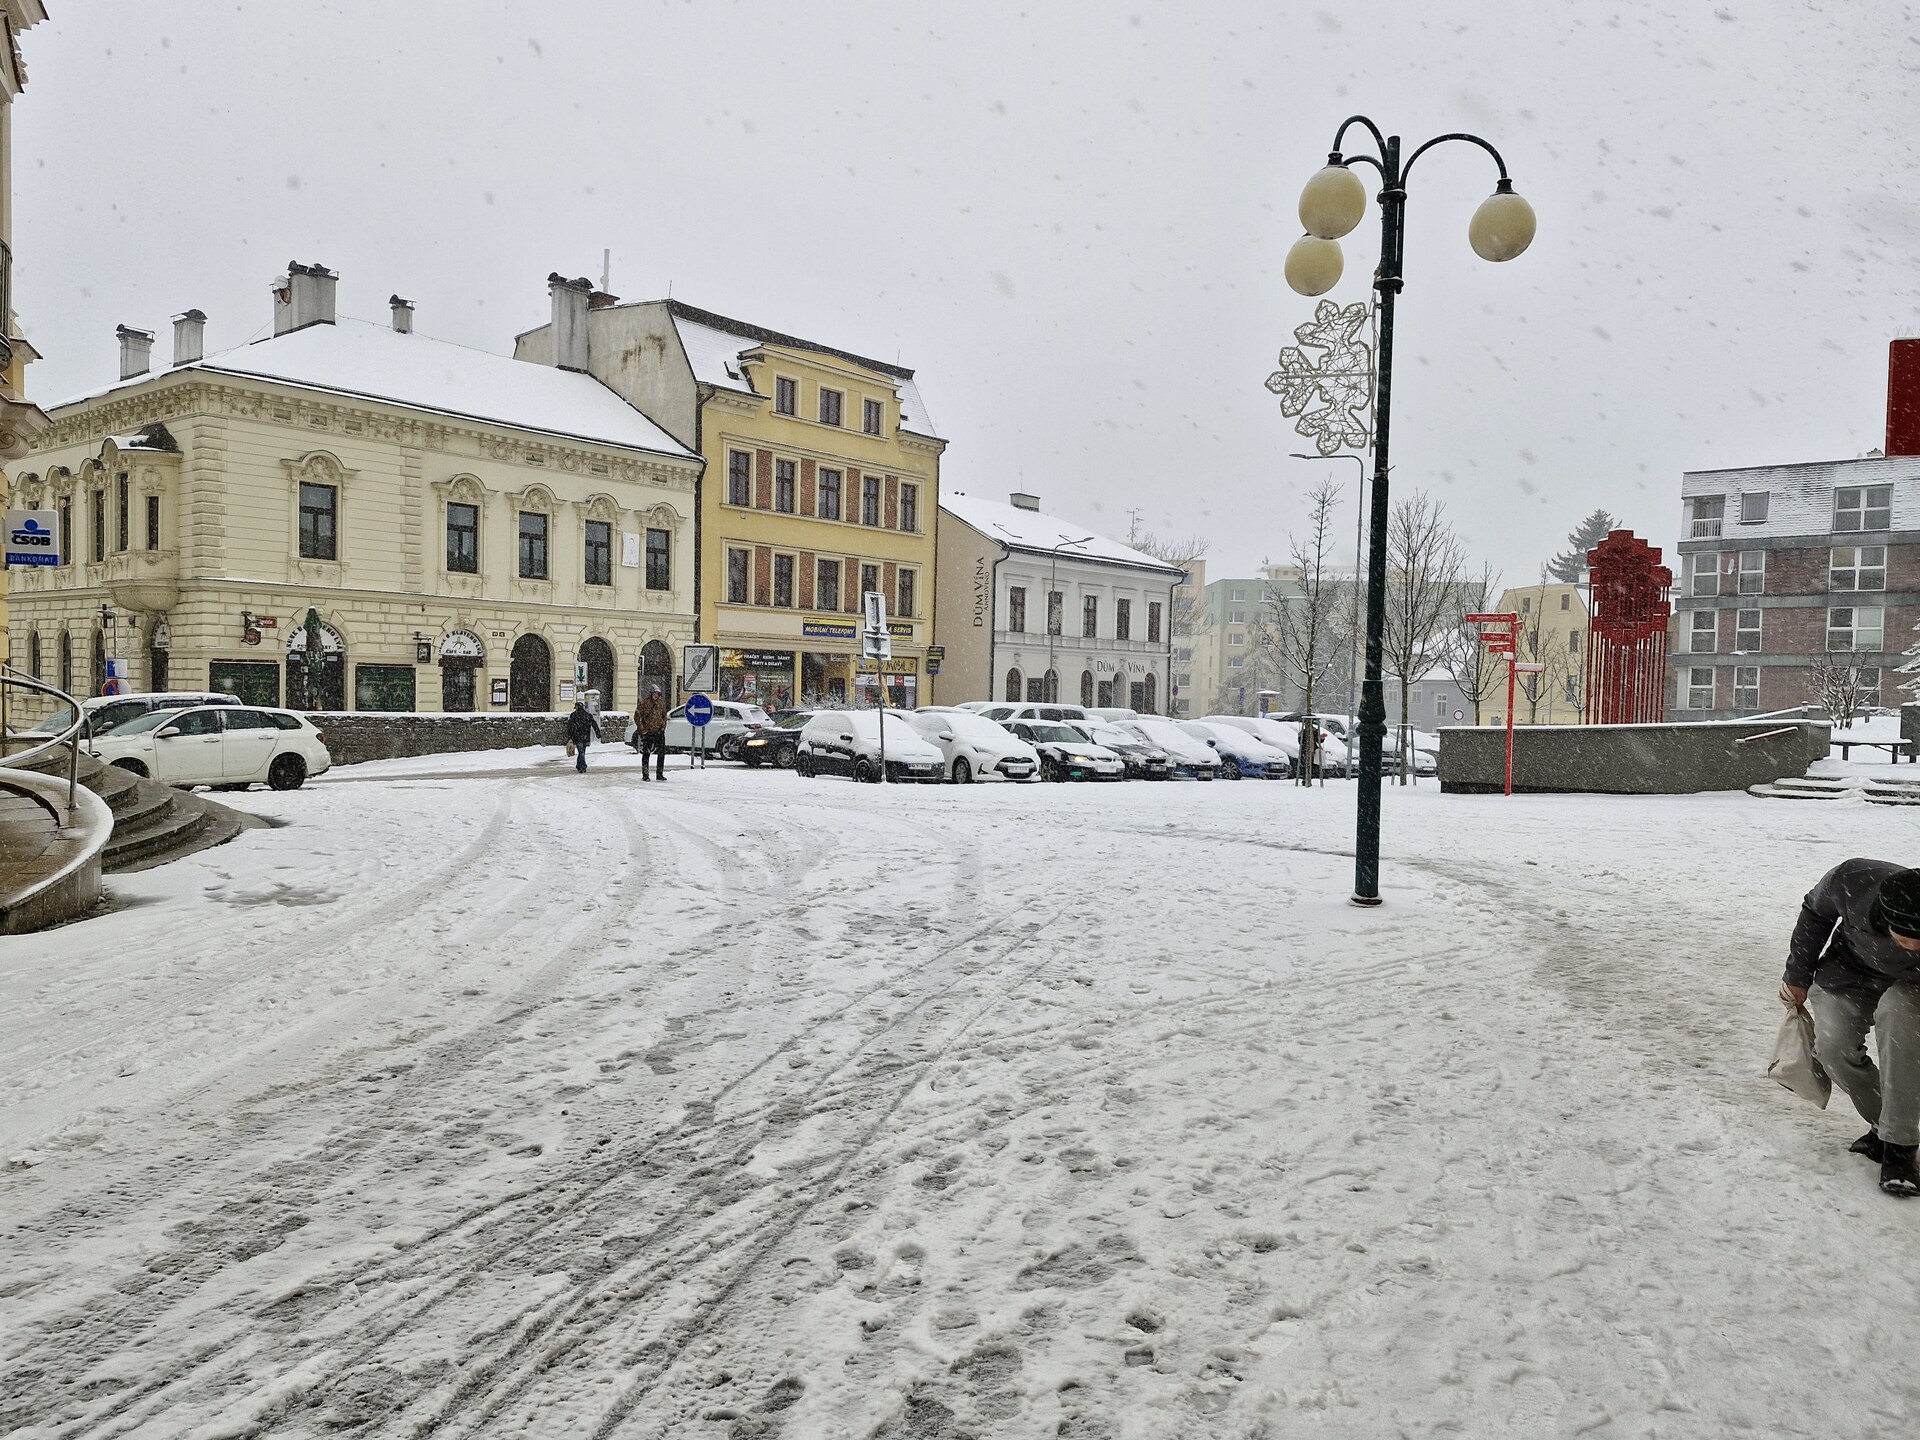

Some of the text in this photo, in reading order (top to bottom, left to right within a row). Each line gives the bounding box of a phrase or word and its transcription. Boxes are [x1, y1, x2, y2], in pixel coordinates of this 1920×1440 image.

[11, 534, 51, 546] ČSOB
[9, 554, 54, 563] BANKOMAT
[973, 556, 984, 627] DŮM VÍNA
[829, 626, 855, 635] TELEFONY
[1097, 660, 1146, 673] DŮM VÍNA
